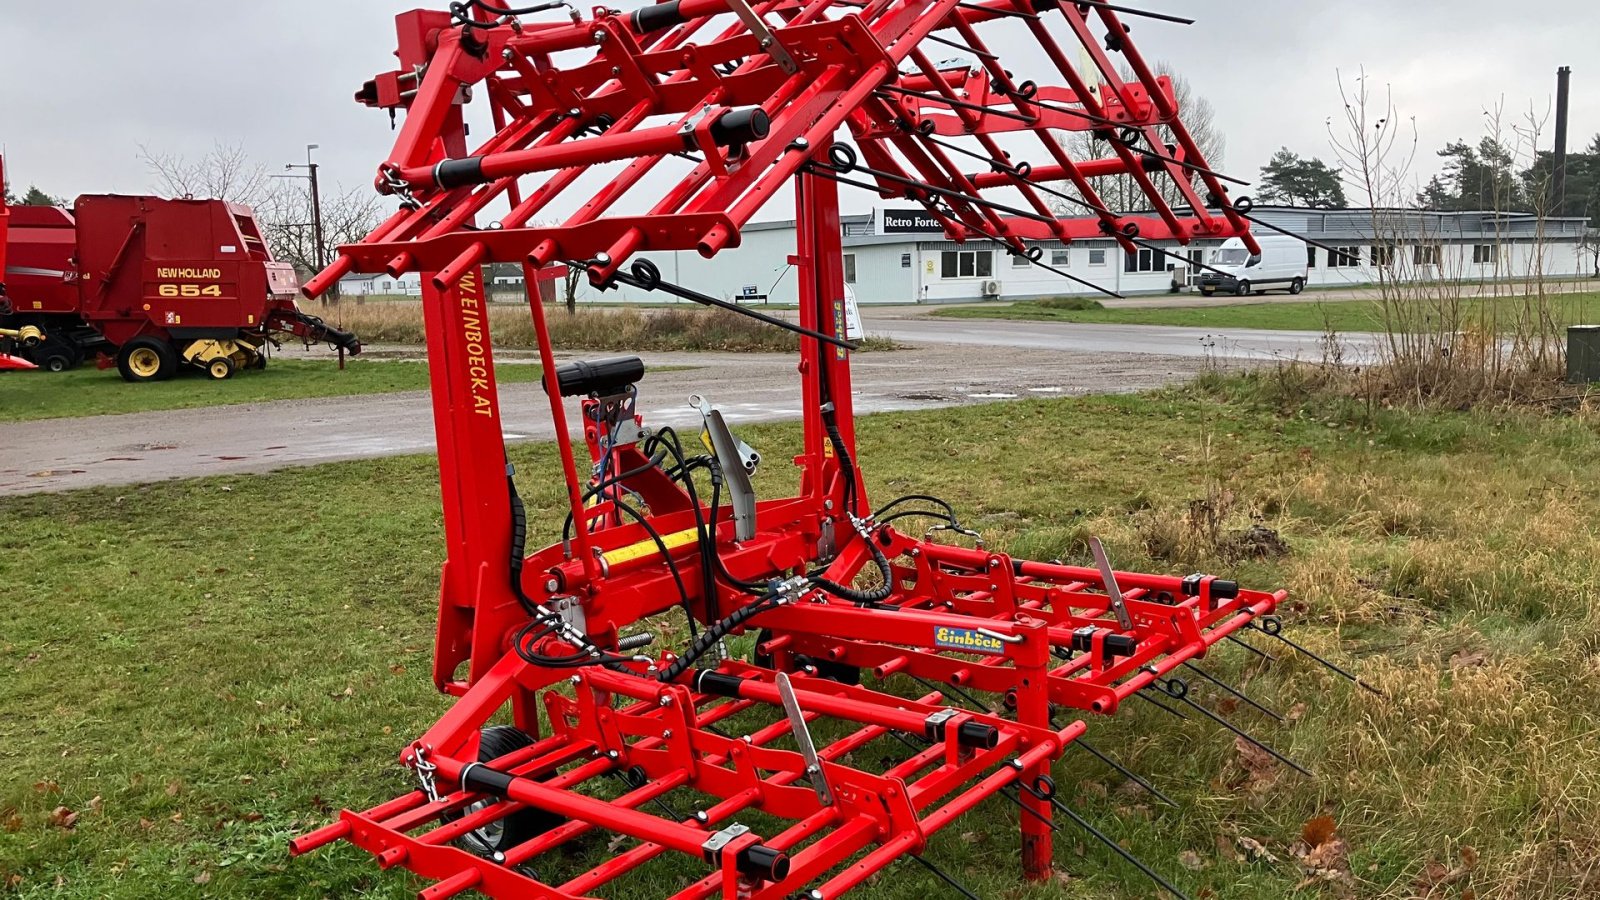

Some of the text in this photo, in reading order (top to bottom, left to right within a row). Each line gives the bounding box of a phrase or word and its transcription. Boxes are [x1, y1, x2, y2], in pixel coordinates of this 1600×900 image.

[885, 216, 943, 227] Retro Forte
[157, 267, 221, 279] NEW HOLLAND
[158, 284, 222, 297] 654
[458, 271, 492, 418] W.EINBOECK.AT
[936, 627, 1002, 649] Einböck
